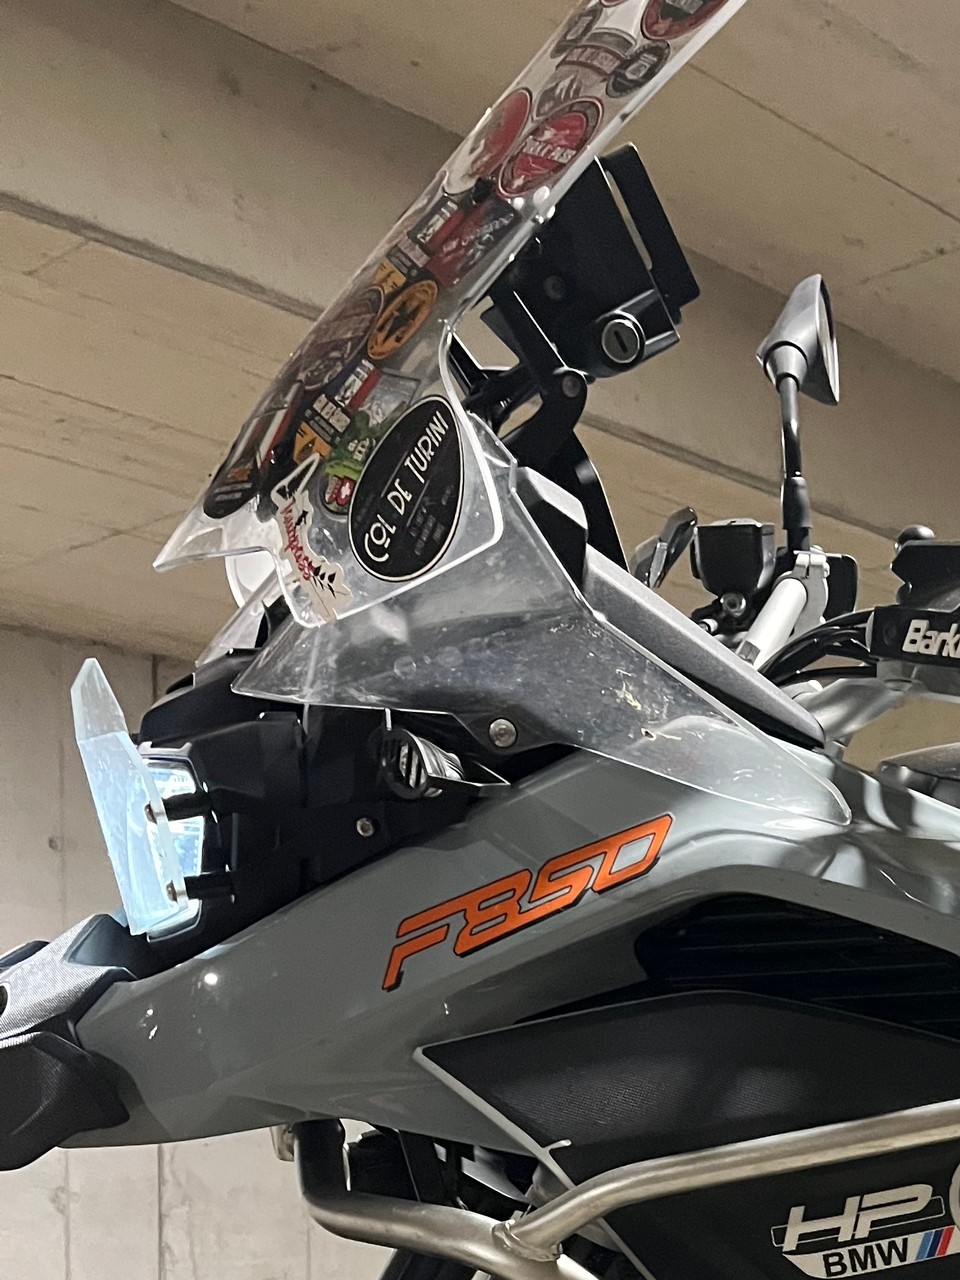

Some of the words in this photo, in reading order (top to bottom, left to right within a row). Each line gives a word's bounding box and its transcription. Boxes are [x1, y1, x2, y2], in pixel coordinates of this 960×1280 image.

[364, 514, 397, 562] COL
[387, 478, 412, 516] DE
[404, 410, 449, 484] TURINI
[382, 813, 675, 992] F850
[782, 1184, 933, 1252] HP
[823, 1237, 908, 1278] BMW
